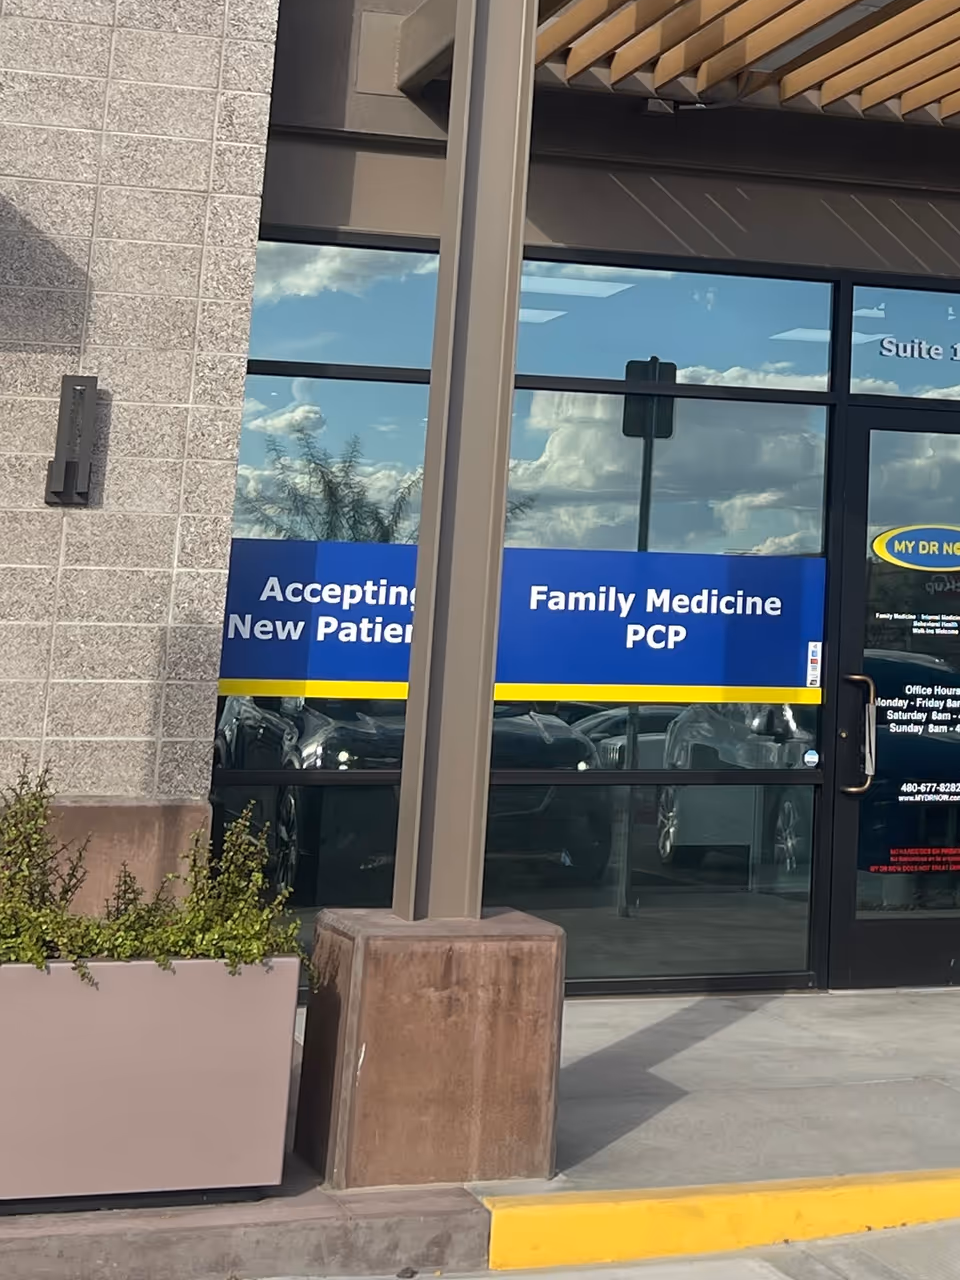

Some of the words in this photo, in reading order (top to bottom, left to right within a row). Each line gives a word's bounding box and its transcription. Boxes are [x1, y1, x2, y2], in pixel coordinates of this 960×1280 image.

[880, 337, 944, 360] Suite
[893, 540, 915, 554] MY
[918, 541, 939, 554] DR
[529, 585, 635, 618] Family
[645, 586, 783, 617] Medicine
[875, 612, 893, 620] Family
[893, 612, 916, 620] Medicine
[228, 613, 305, 641] New
[625, 623, 687, 650] PCP
[905, 685, 932, 695] Office
[934, 685, 960, 695] Hours
[916, 698, 944, 710] Friday
[887, 710, 928, 722] Saturday
[889, 723, 924, 735] Sunday
[928, 724, 948, 733] 8am
